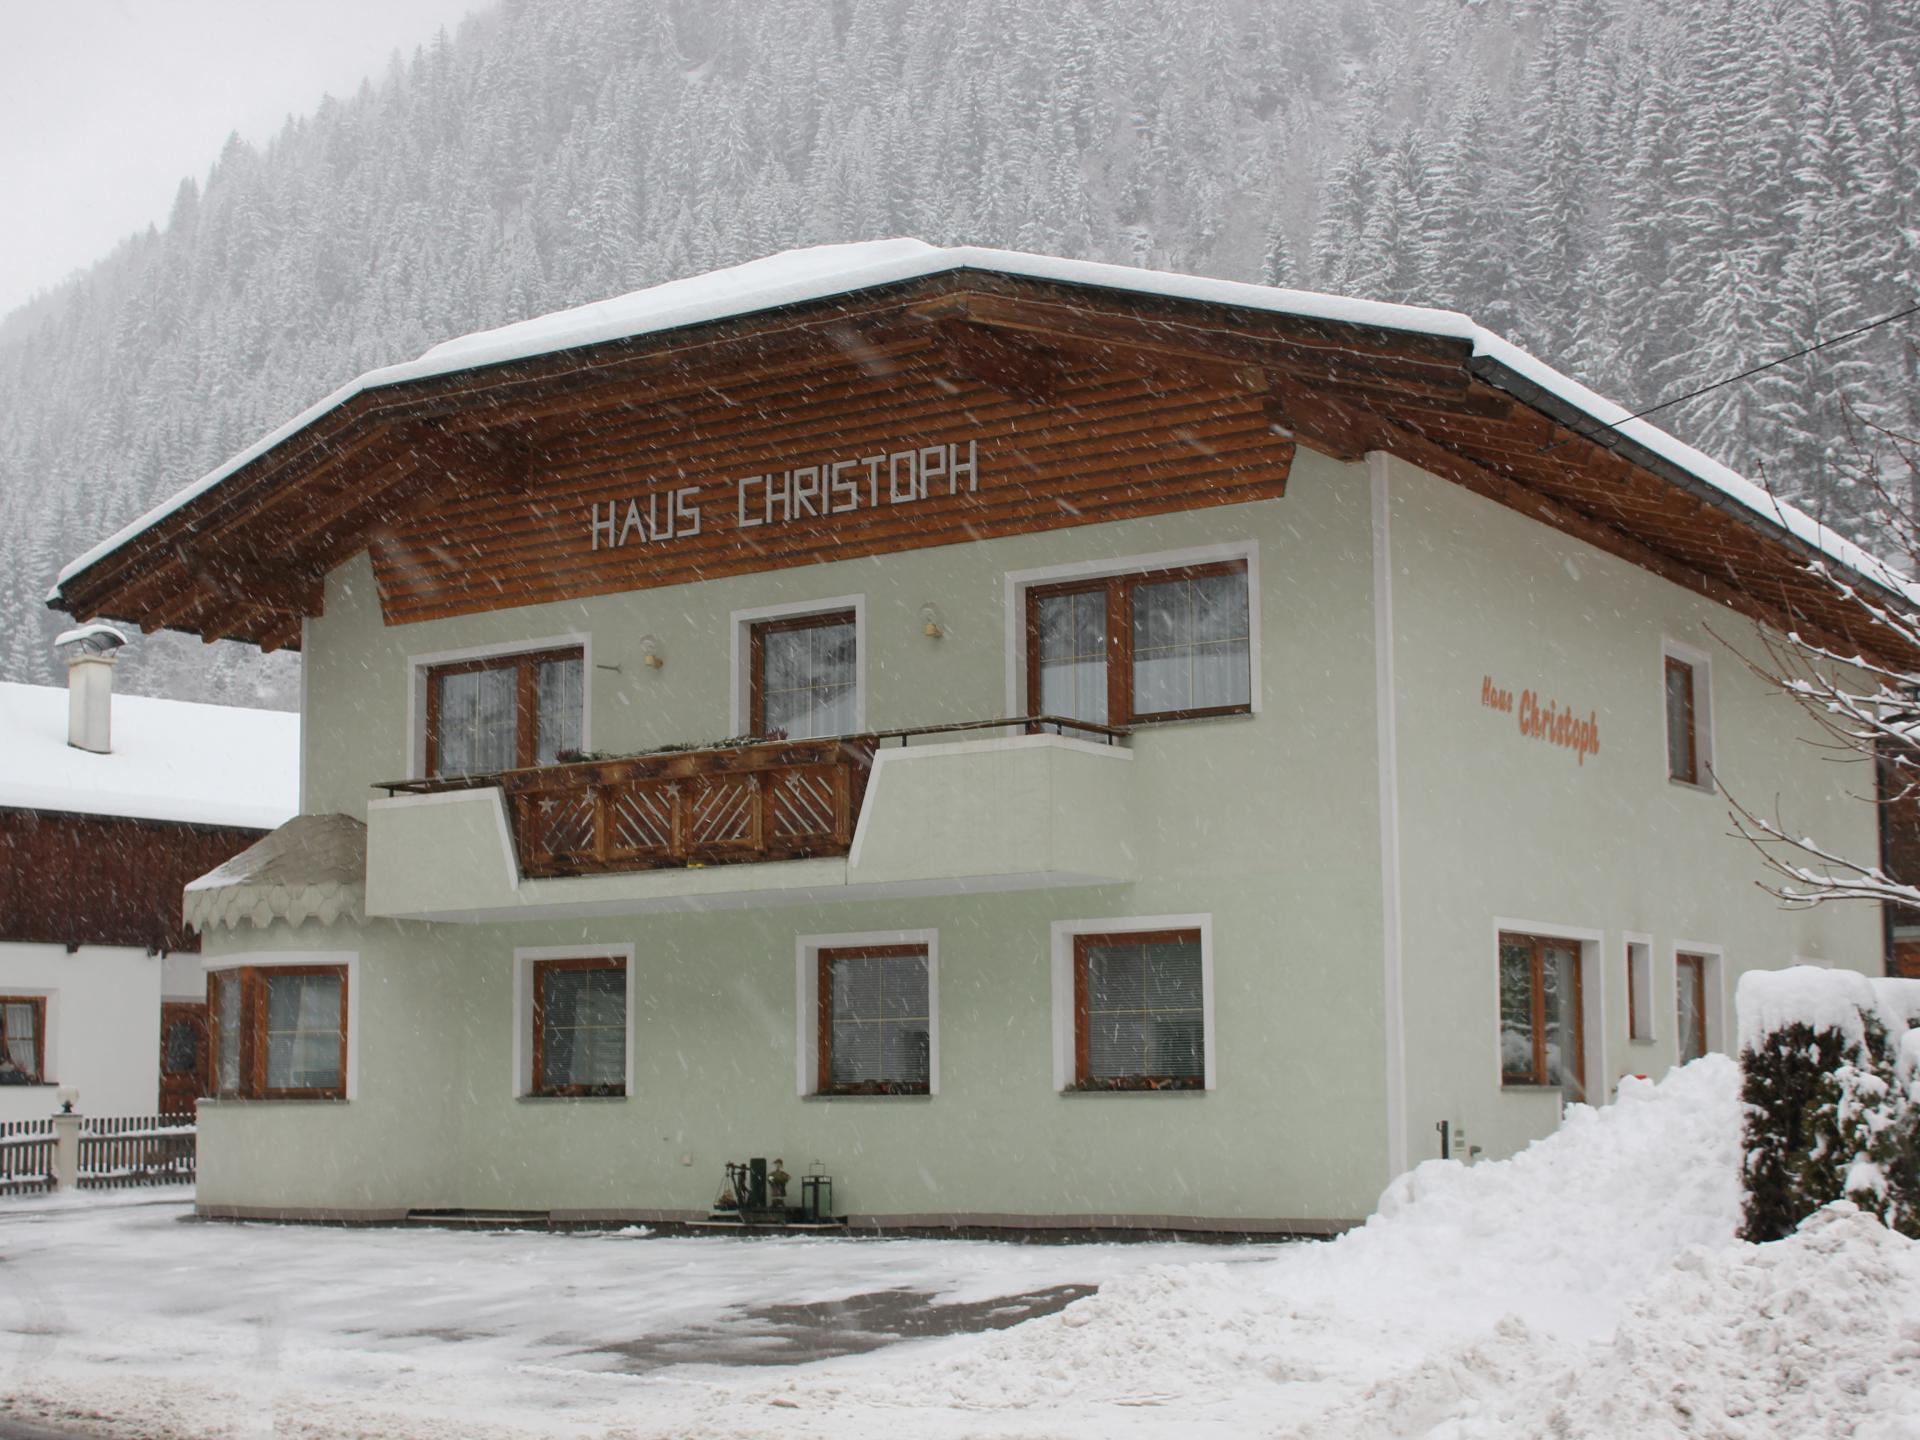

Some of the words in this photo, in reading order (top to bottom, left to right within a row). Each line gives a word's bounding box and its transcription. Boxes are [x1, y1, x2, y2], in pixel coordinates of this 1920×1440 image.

[592, 486, 700, 550] HAUS
[738, 440, 978, 528] CHRISTOPH
[1482, 674, 1513, 714] Haus
[1519, 688, 1600, 767] Christoph
